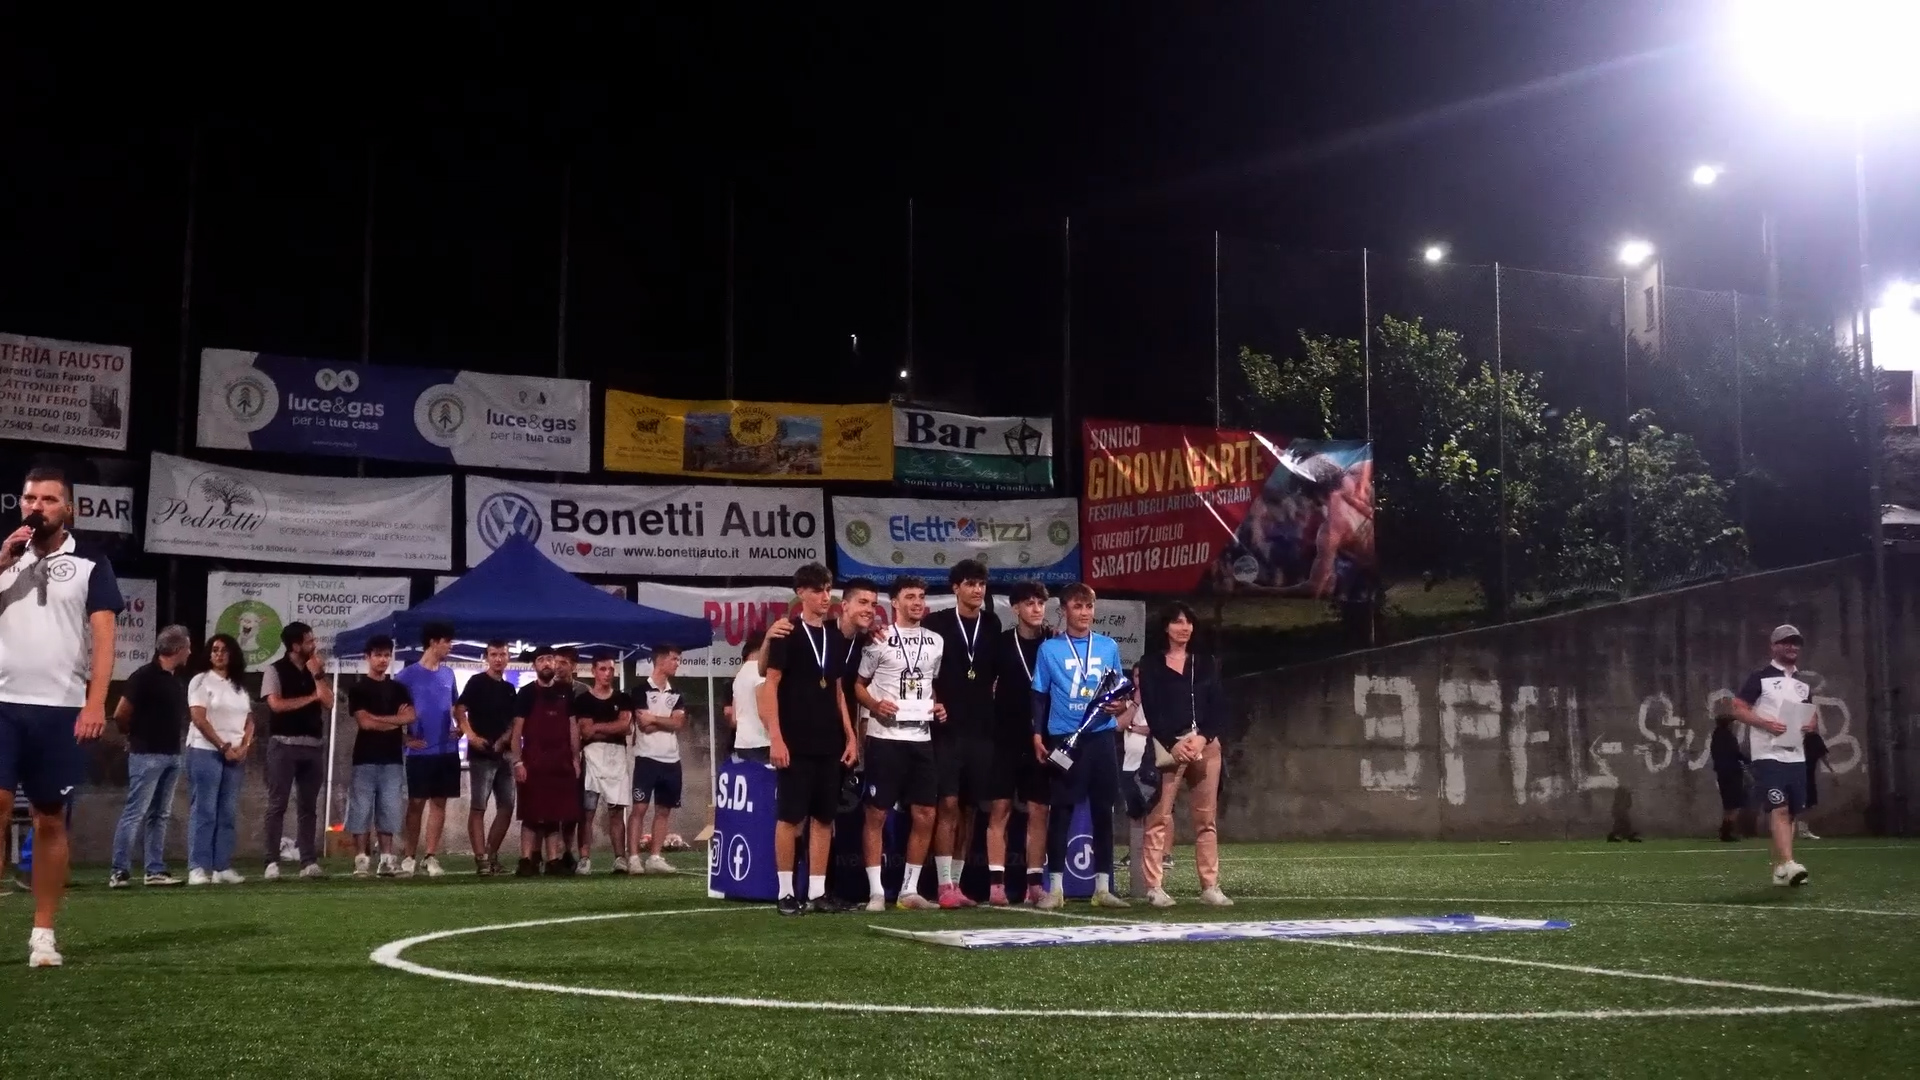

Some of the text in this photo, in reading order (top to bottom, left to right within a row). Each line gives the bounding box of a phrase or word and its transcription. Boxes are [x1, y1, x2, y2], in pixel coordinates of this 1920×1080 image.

[58, 350, 124, 372] FAUSTO
[62, 371, 96, 383] Fausto
[26, 393, 41, 403] IN
[46, 395, 88, 408] FERRO
[28, 407, 60, 419] EDOLO
[62, 410, 81, 422] (BS)
[291, 416, 379, 431] per la tua casa
[490, 431, 572, 445] per la tua casa
[902, 411, 987, 449] Bar
[1090, 425, 1141, 449] SONICO
[1087, 438, 1265, 501] GIROVAGARTE
[904, 477, 937, 488] Sonico
[941, 481, 963, 489] (BS)
[975, 483, 991, 491] Via
[78, 497, 129, 521] BAR
[1088, 502, 1135, 523] FESTIVAL
[1137, 500, 1165, 516] DEGLI
[1216, 486, 1251, 506] STRADA
[152, 496, 262, 533] Pedrotti
[550, 499, 704, 536] Bonetti
[719, 501, 816, 538] Auto
[1135, 525, 1150, 545] 17
[1150, 523, 1184, 544] LUGLIO
[551, 541, 817, 560] We car www.bonettiauto.it MALONNO
[1092, 541, 1211, 579] SABATO 18 LUGLIO
[298, 580, 346, 590] VENDITA
[298, 593, 405, 605] FORMAGGI, RICOTTE
[297, 605, 352, 615] E YOGURT
[129, 650, 149, 662] (Bs)
[679, 657, 709, 666] ionale,
[712, 657, 722, 666] 46
[728, 656, 745, 666] SO
[1064, 656, 1102, 699] 75
